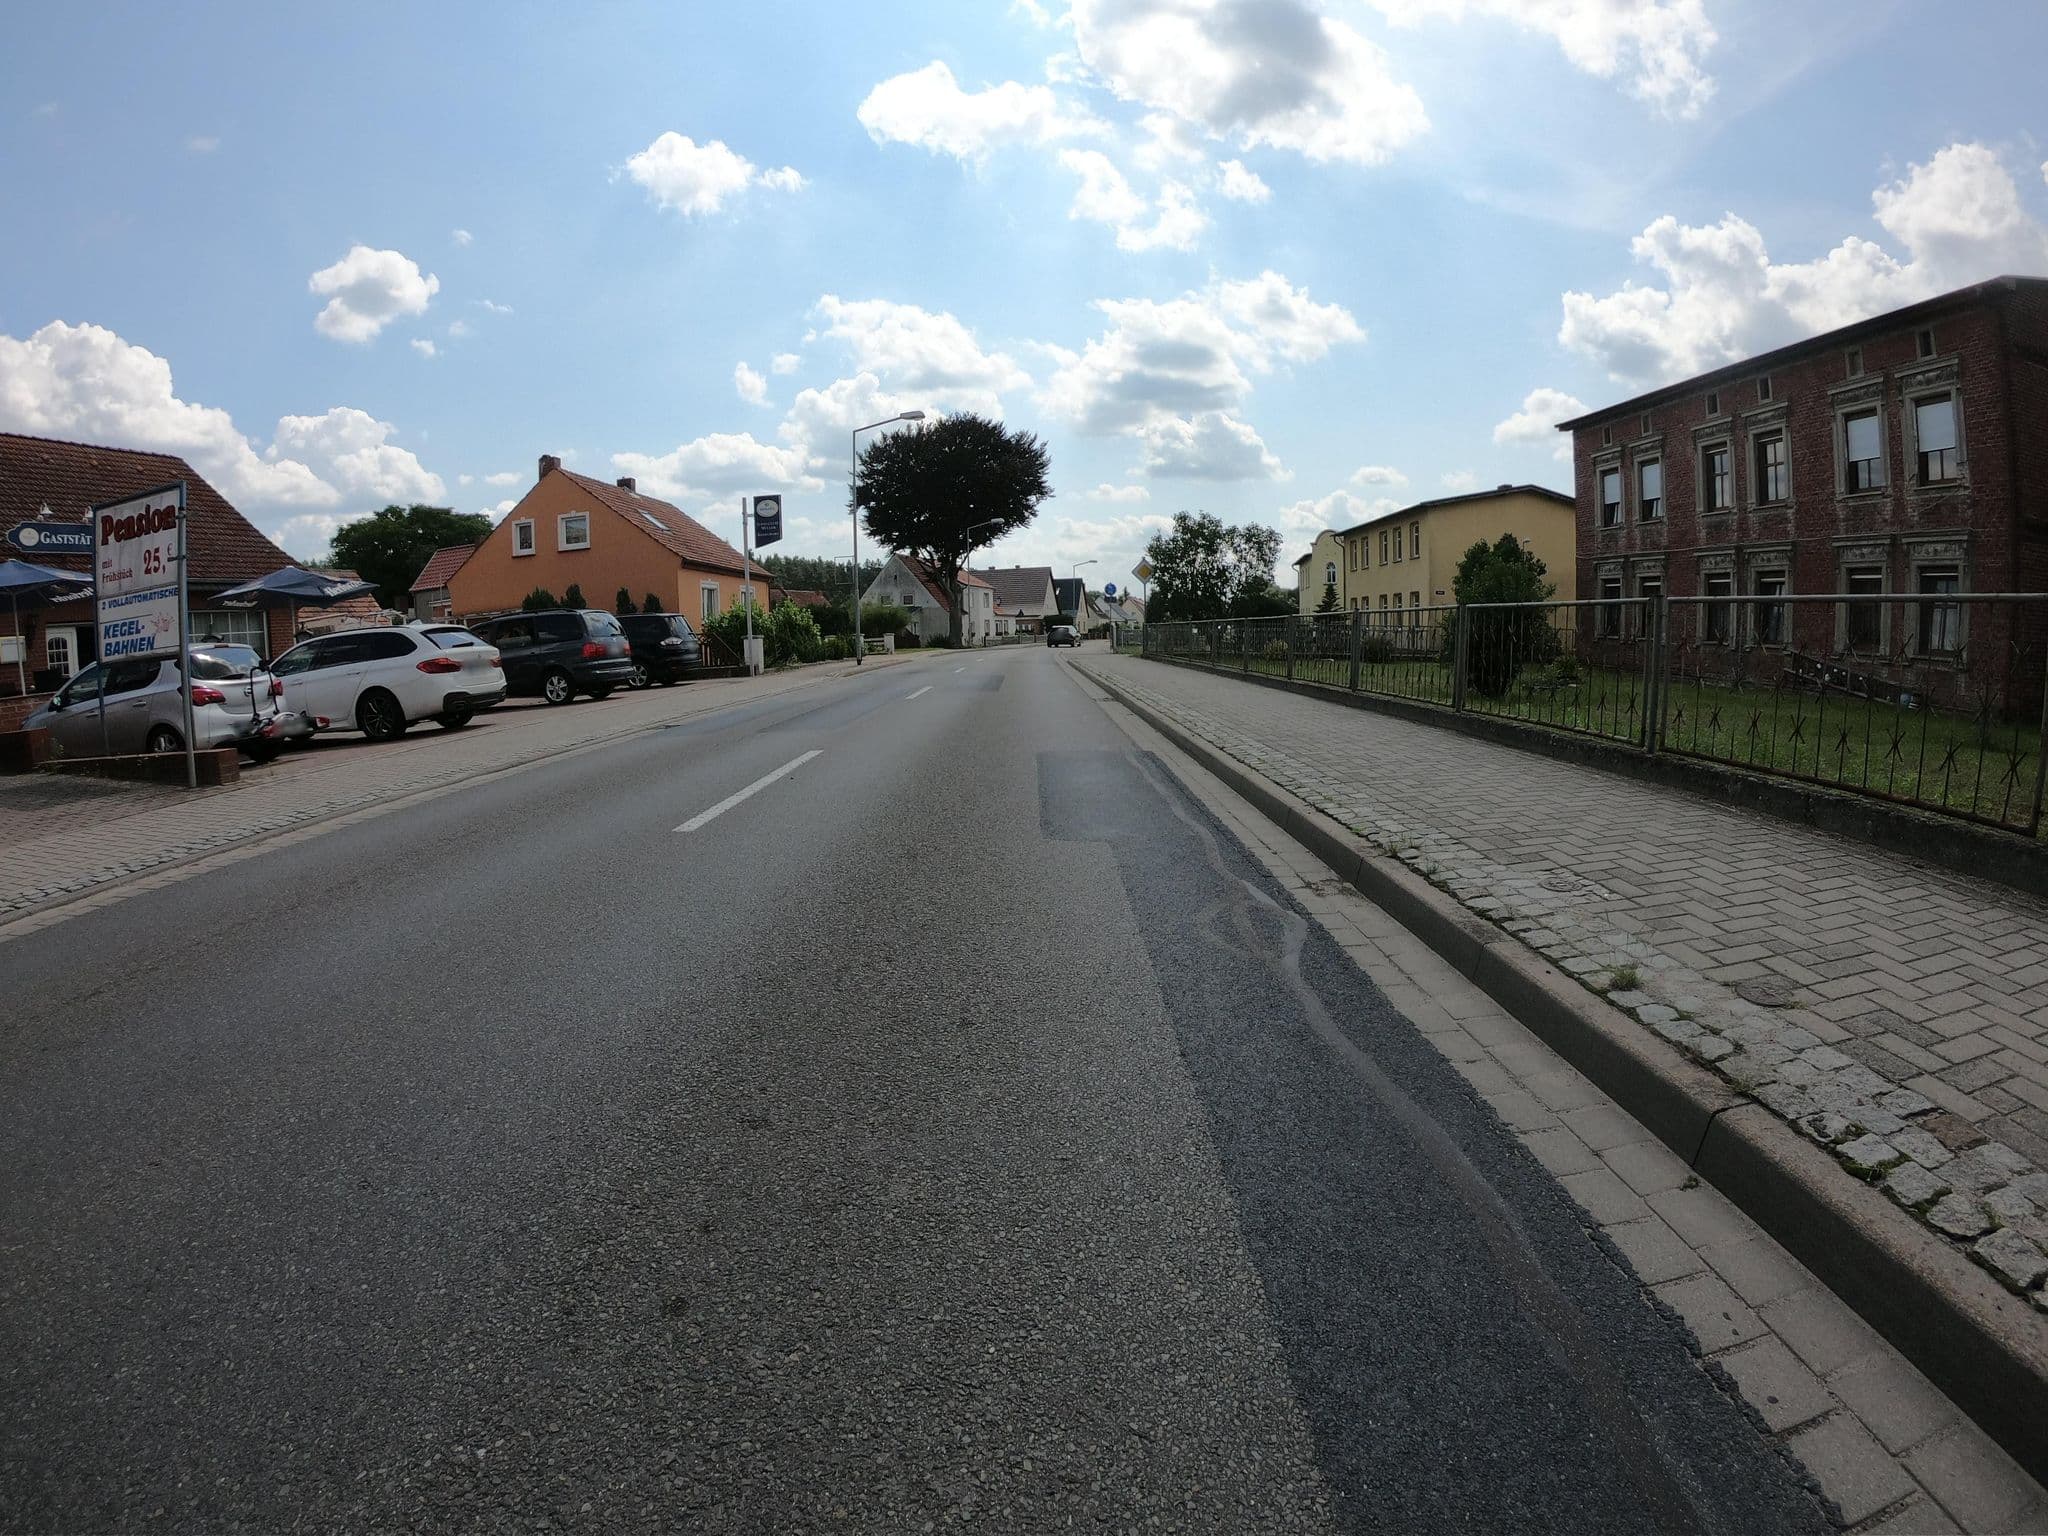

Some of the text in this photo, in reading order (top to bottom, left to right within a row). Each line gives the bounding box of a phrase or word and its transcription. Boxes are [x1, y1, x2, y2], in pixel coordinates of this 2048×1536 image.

[101, 504, 176, 546] Pension
[108, 587, 178, 608] VOLLAUTOMATISCHE
[103, 620, 145, 640] KEGEL-
[104, 636, 155, 657] BAHNEN
